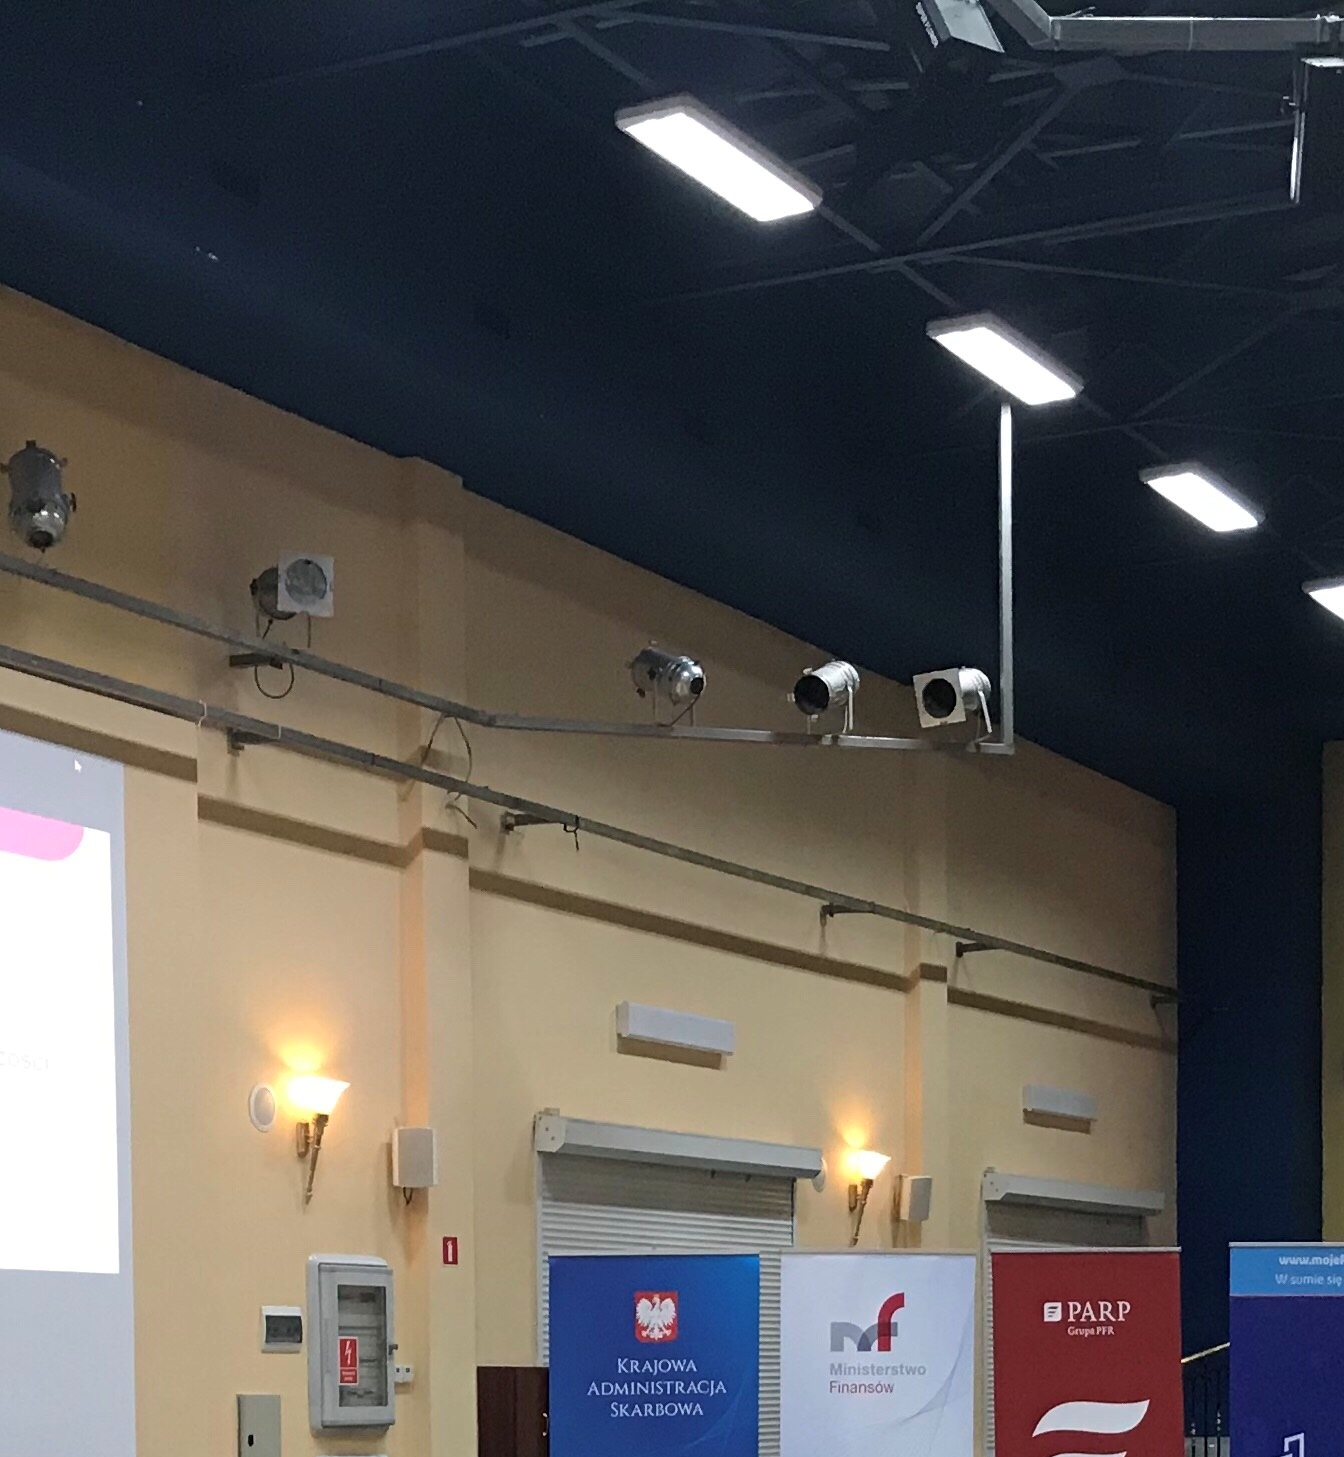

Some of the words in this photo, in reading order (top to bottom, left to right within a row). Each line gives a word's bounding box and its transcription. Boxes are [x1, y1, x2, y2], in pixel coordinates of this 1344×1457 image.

[1275, 1273, 1288, 1285] W
[1290, 1274, 1324, 1285] sumie
[1327, 1274, 1343, 1287] się
[1067, 1301, 1131, 1322] PARP
[1096, 1325, 1115, 1336] PFR
[829, 1362, 927, 1377] Ministerstwo
[829, 1380, 895, 1394] Finansów
